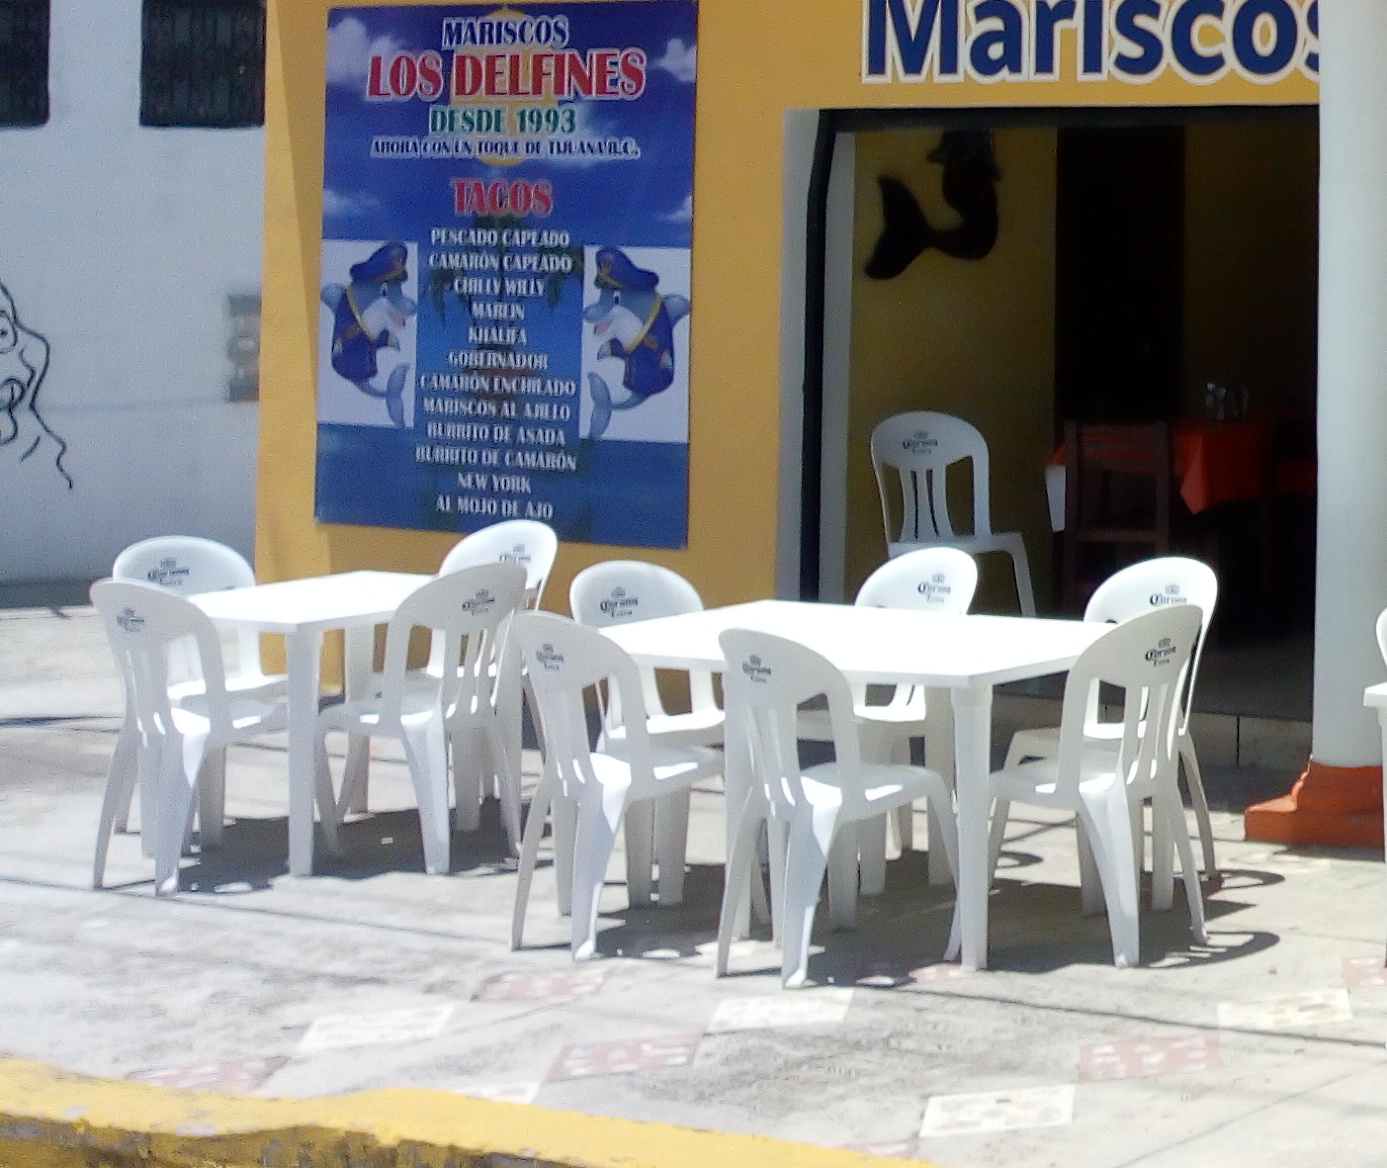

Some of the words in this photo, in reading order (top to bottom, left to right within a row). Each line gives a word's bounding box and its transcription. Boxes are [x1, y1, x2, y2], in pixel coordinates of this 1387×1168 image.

[443, 16, 569, 49] MARISCOS
[367, 50, 443, 101] LOS
[453, 48, 647, 100] DELFINES
[429, 106, 507, 134] DESDE
[516, 107, 576, 133] 1993
[452, 178, 553, 216] TACOS
